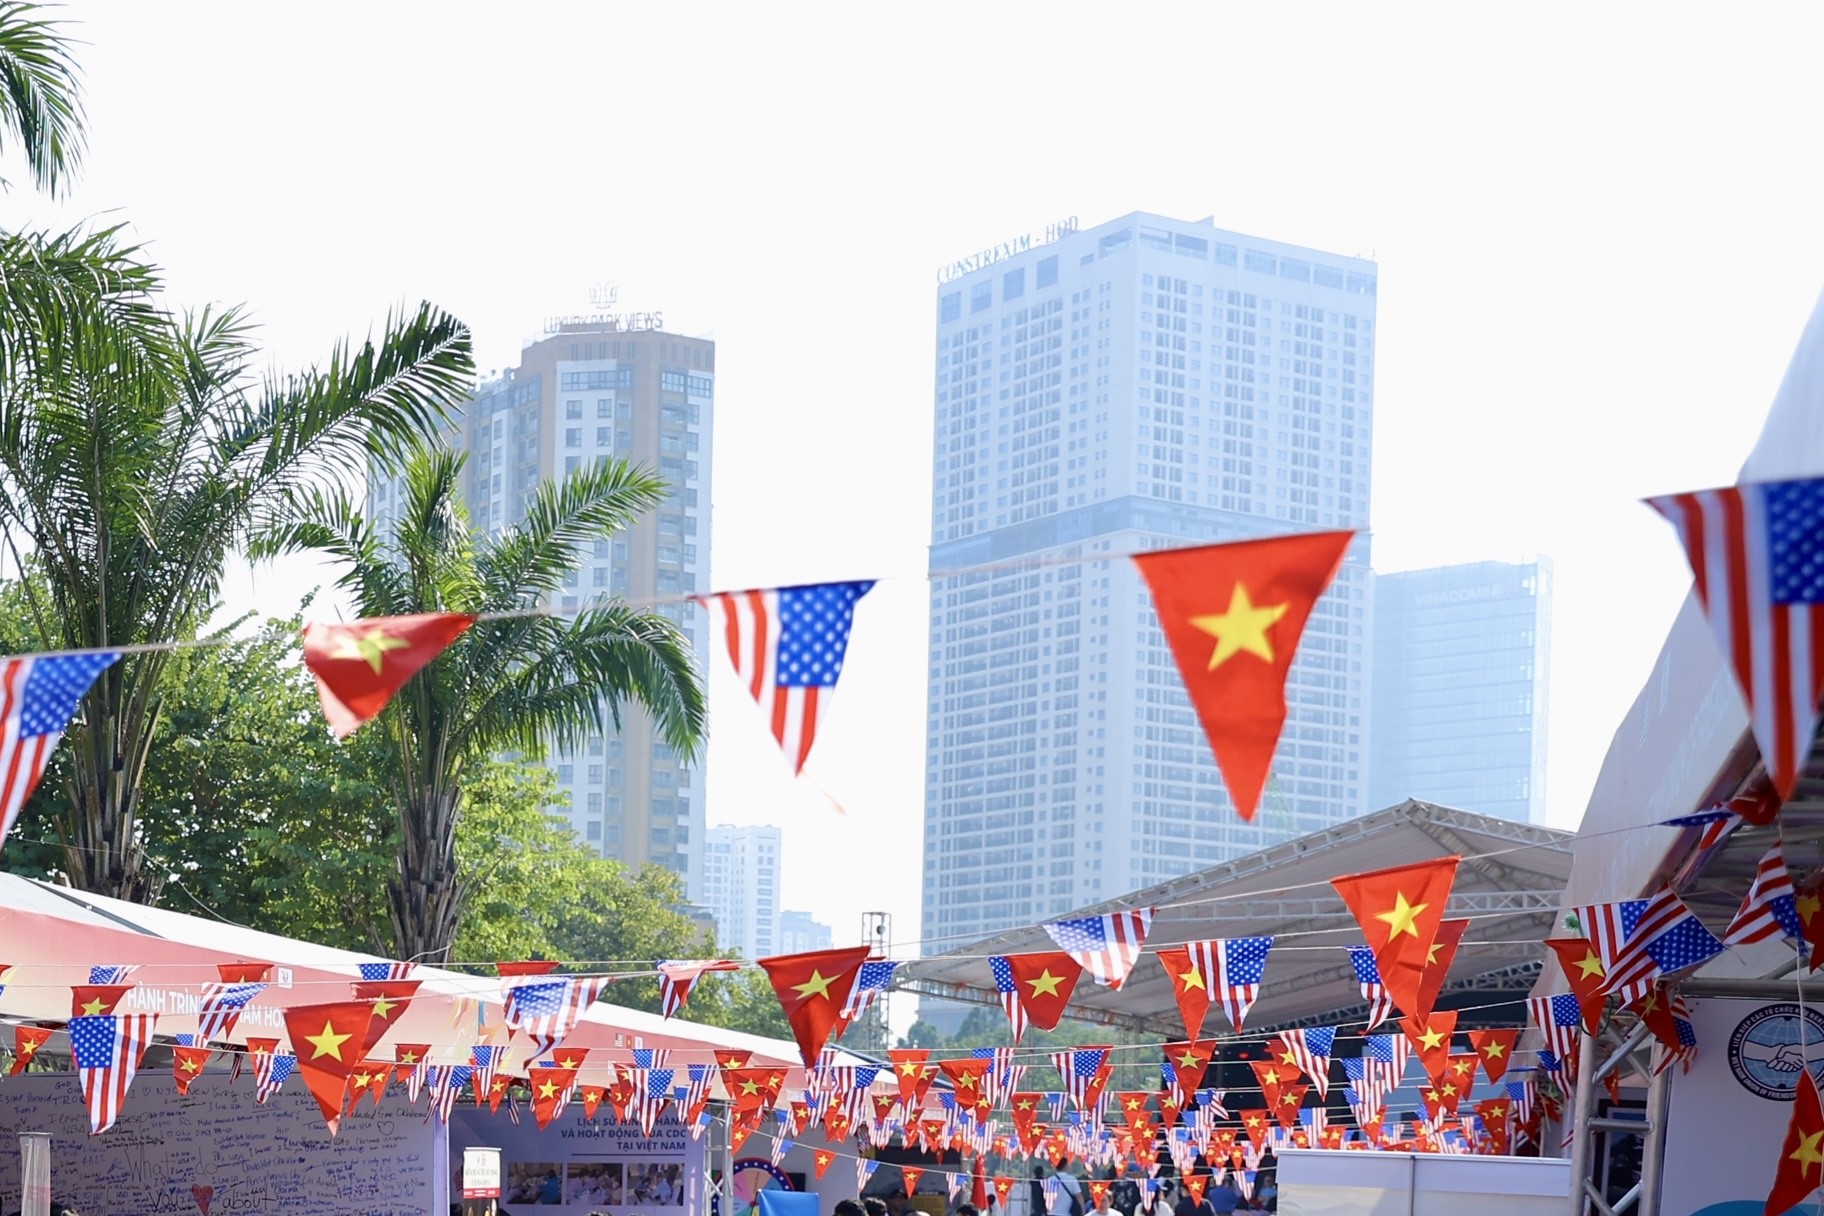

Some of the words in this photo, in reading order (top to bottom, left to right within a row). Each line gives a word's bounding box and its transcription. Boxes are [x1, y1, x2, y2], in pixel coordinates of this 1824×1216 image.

[936, 233, 1031, 284] CONSTREXIM
[626, 312, 663, 329] VIEWS
[128, 982, 165, 1011] HÀNH
[170, 987, 200, 1016] TRÌN
[561, 1127, 575, 1139] VÀ
[578, 1129, 606, 1141] HOẠT
[608, 1127, 639, 1140] ĐỘNG
[666, 1129, 686, 1138] CDC
[617, 1141, 634, 1152] TẠI
[637, 1140, 658, 1153] VIỆT
[660, 1141, 686, 1150] NAM
[222, 1188, 277, 1210] about
